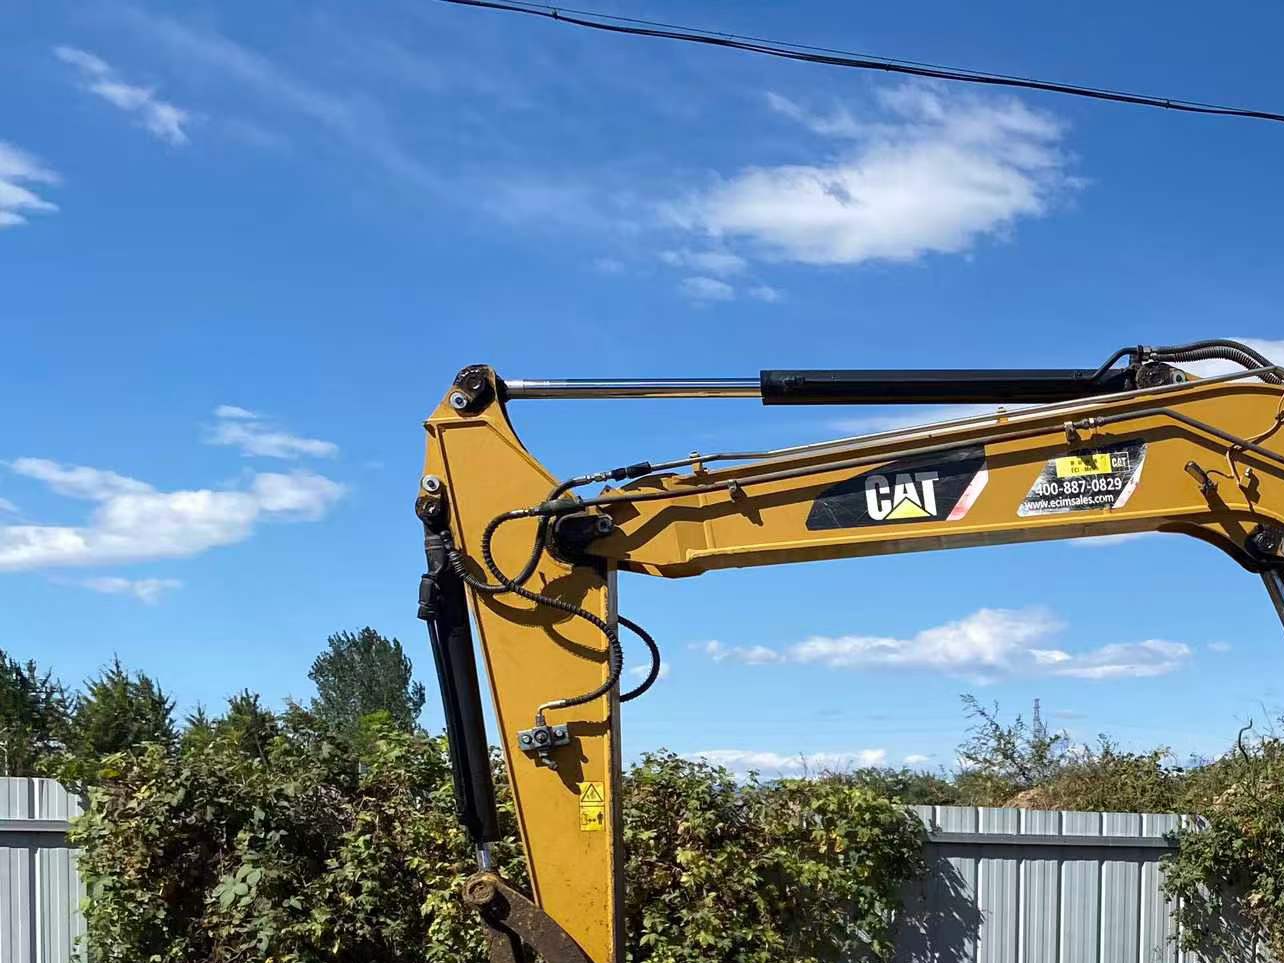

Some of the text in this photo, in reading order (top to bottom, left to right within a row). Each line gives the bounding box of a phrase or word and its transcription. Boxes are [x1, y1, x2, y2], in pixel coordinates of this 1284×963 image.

[1111, 457, 1127, 468] CAT
[1036, 477, 1122, 496] 400-887-0829
[865, 472, 939, 520] CAT
[1024, 494, 1114, 509] www.ecimsales.com
